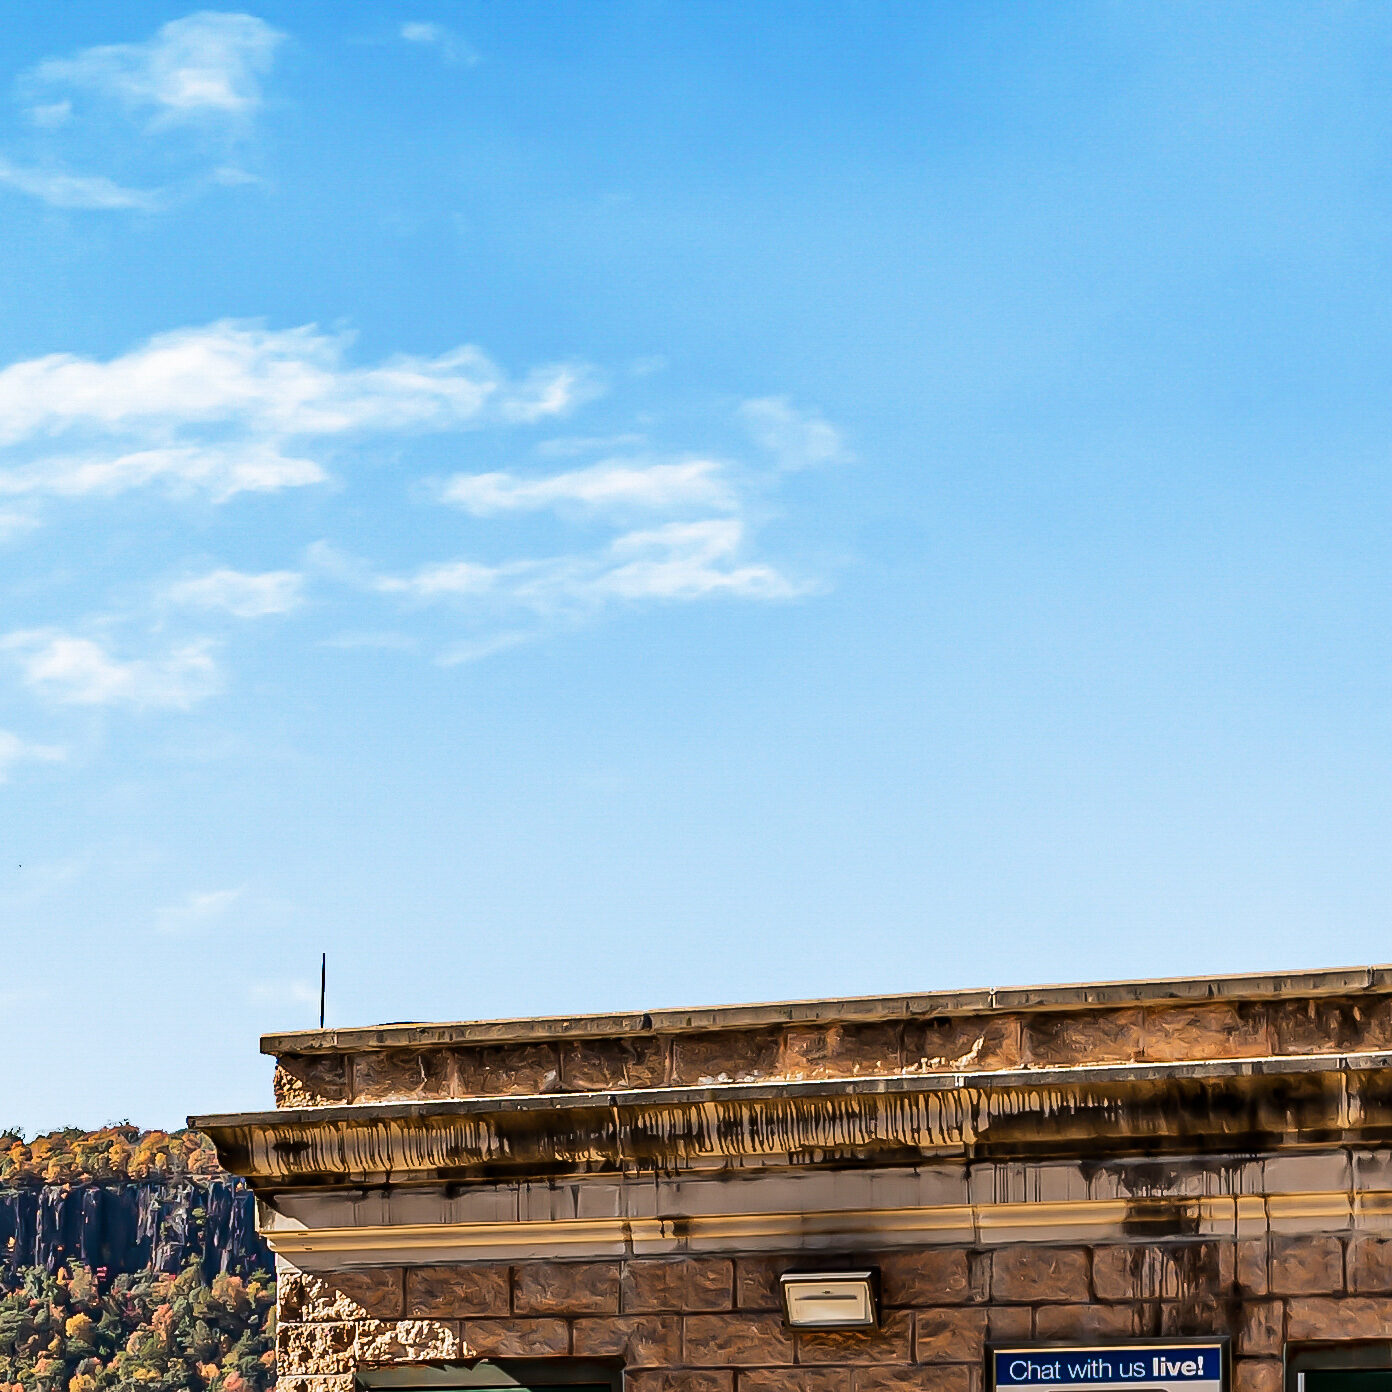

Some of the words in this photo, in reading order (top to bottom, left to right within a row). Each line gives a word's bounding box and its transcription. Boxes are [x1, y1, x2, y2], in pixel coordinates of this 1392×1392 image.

[1009, 1361, 1061, 1380] Chat
[1067, 1358, 1112, 1379] with
[1120, 1362, 1145, 1378] us
[1152, 1356, 1204, 1377] live!
